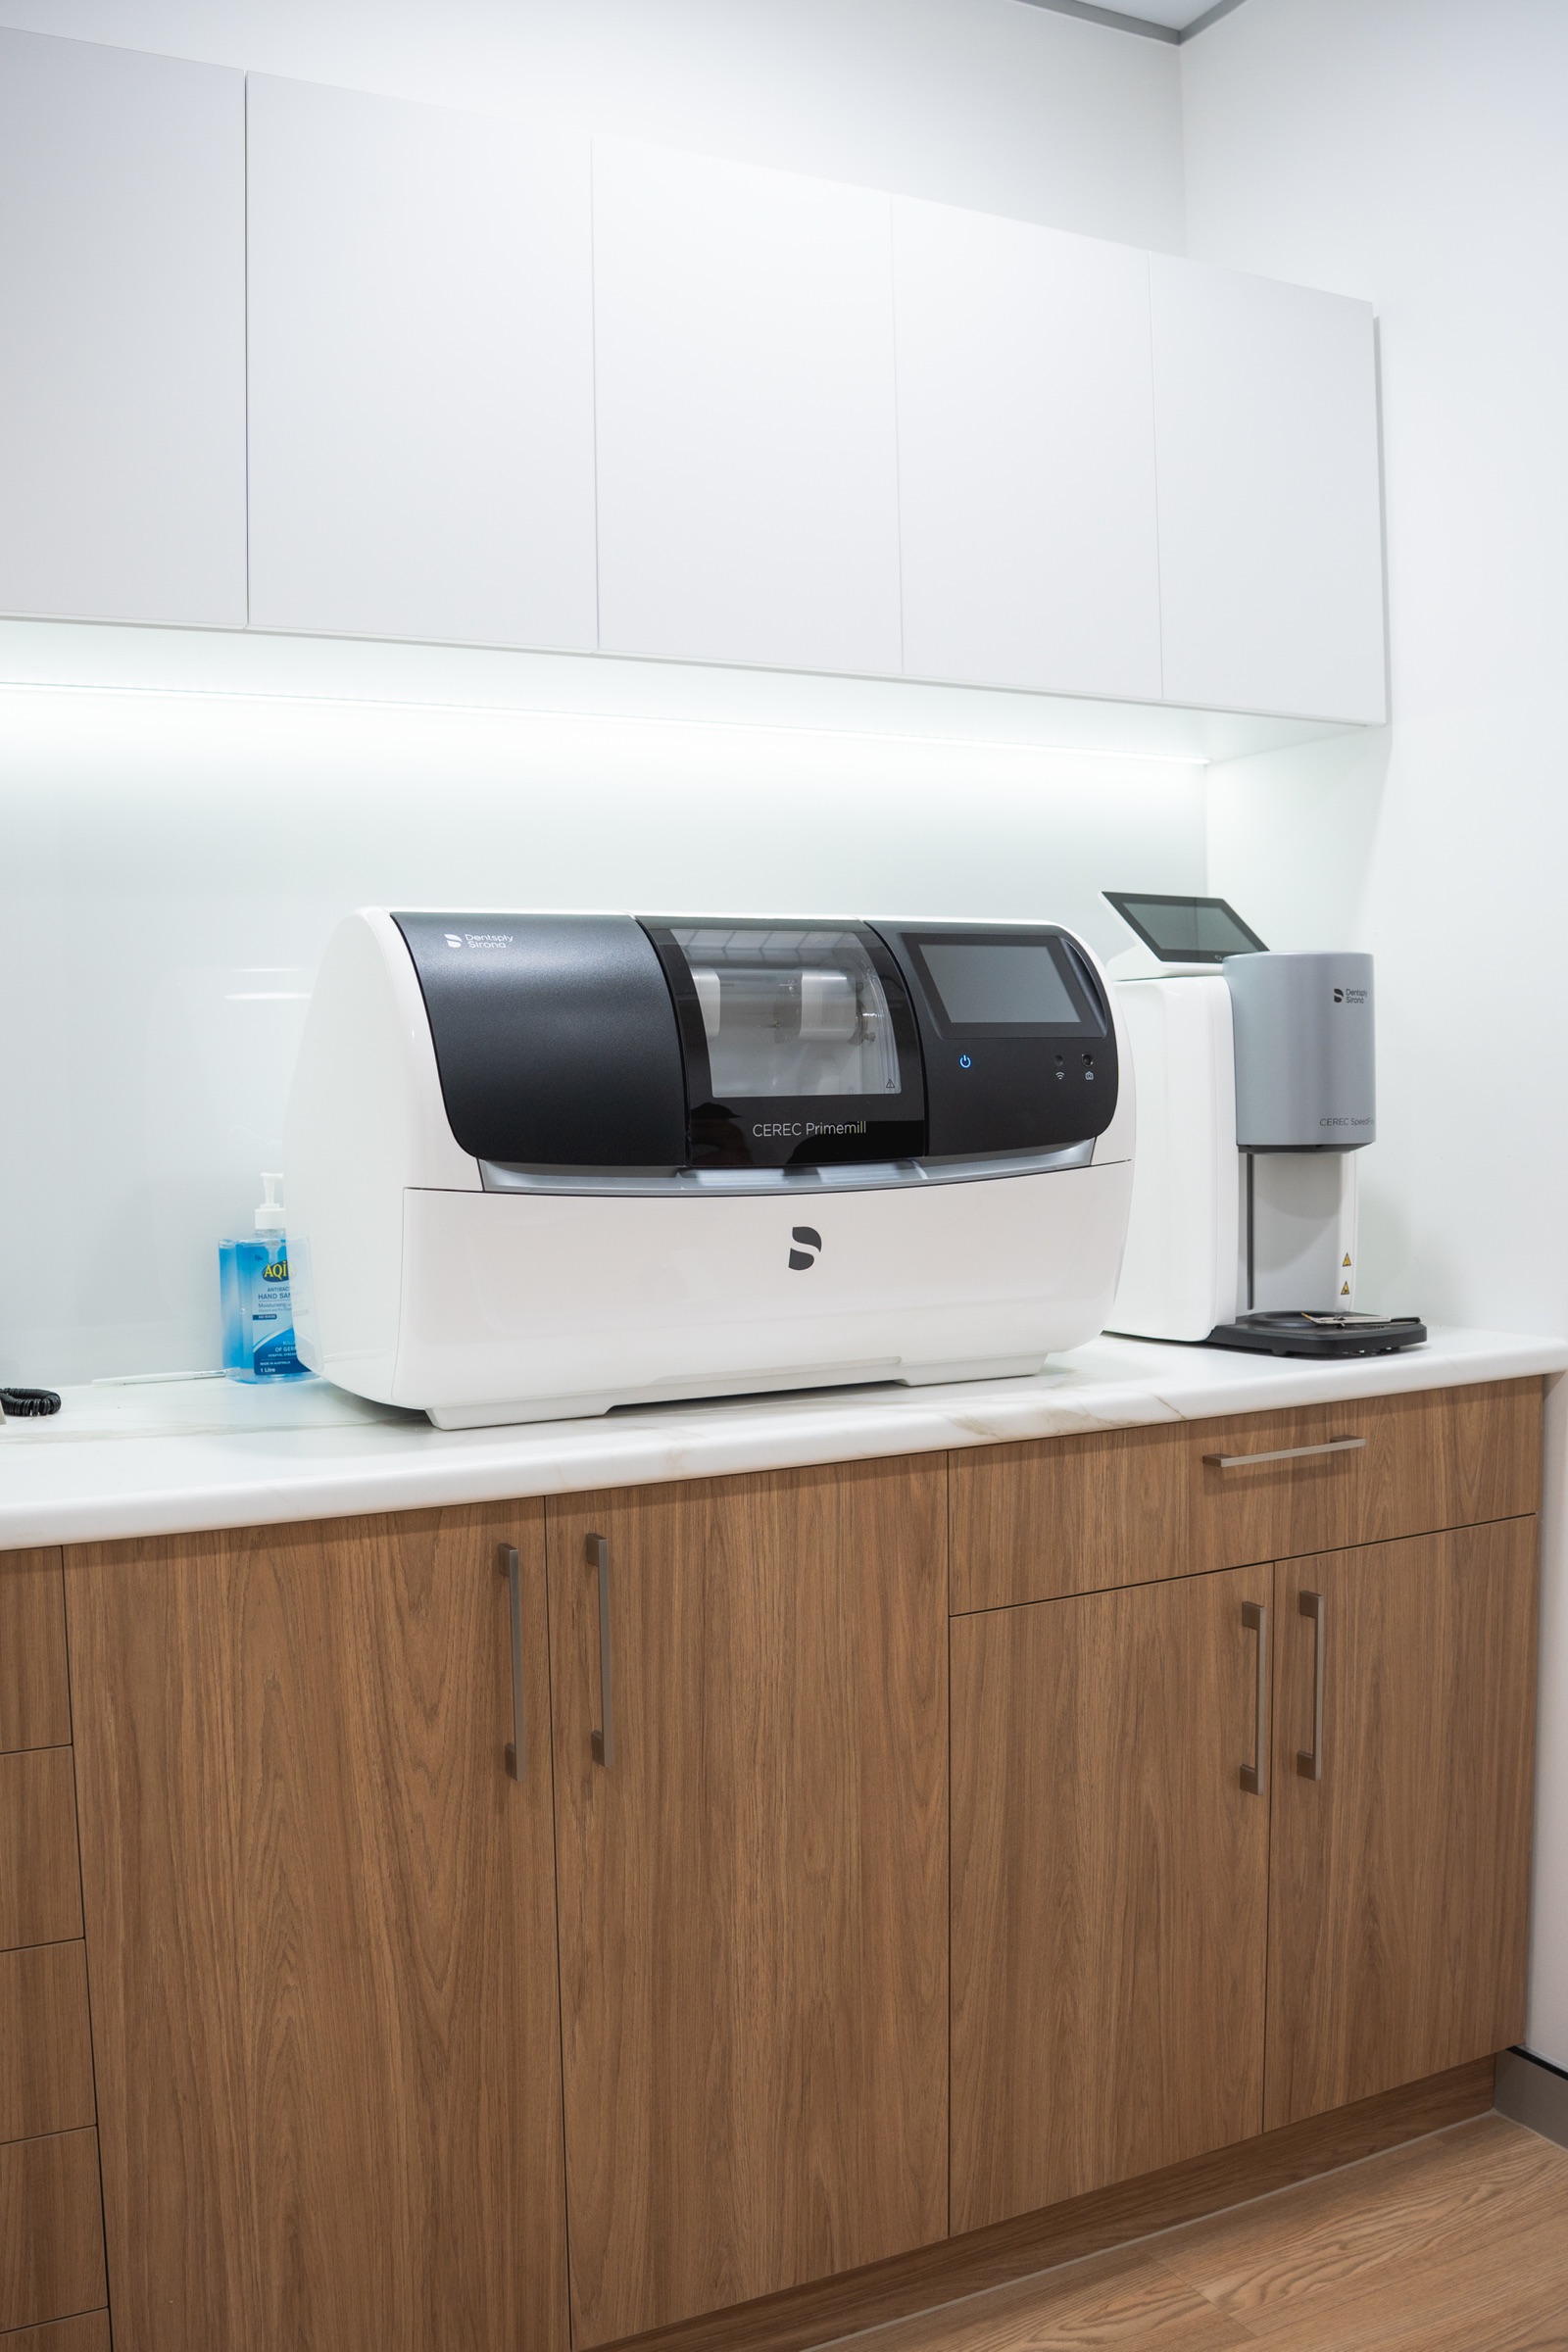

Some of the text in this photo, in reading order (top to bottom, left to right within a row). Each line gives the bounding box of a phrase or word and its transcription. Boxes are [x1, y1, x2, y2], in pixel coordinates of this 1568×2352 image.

[465, 934, 514, 943] Dentsply
[1319, 1117, 1349, 1127] CEREC
[752, 1120, 867, 1138] CEREC Primemill
